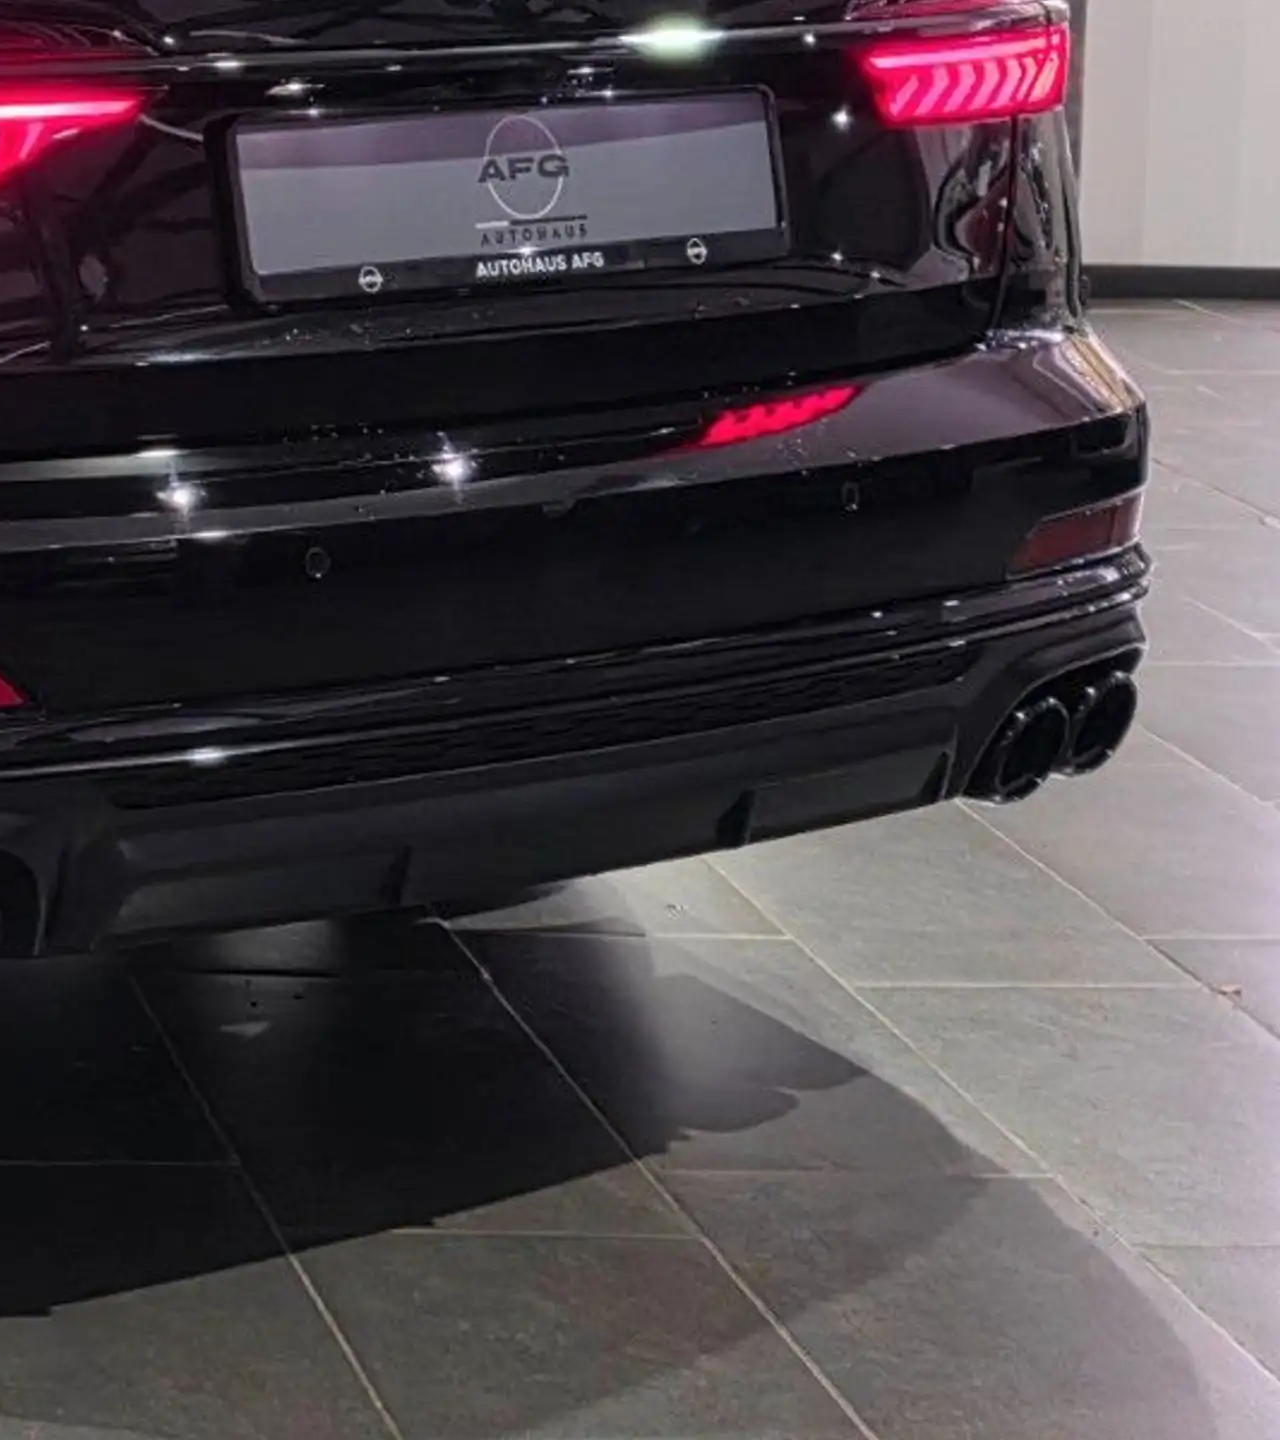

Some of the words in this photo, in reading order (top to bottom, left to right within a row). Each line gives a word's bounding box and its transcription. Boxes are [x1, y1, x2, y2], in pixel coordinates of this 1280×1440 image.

[477, 153, 570, 183] AFG
[479, 224, 588, 247] AUTOHAUS
[475, 254, 568, 278] AUTOHAUS
[572, 251, 605, 270] AFG
